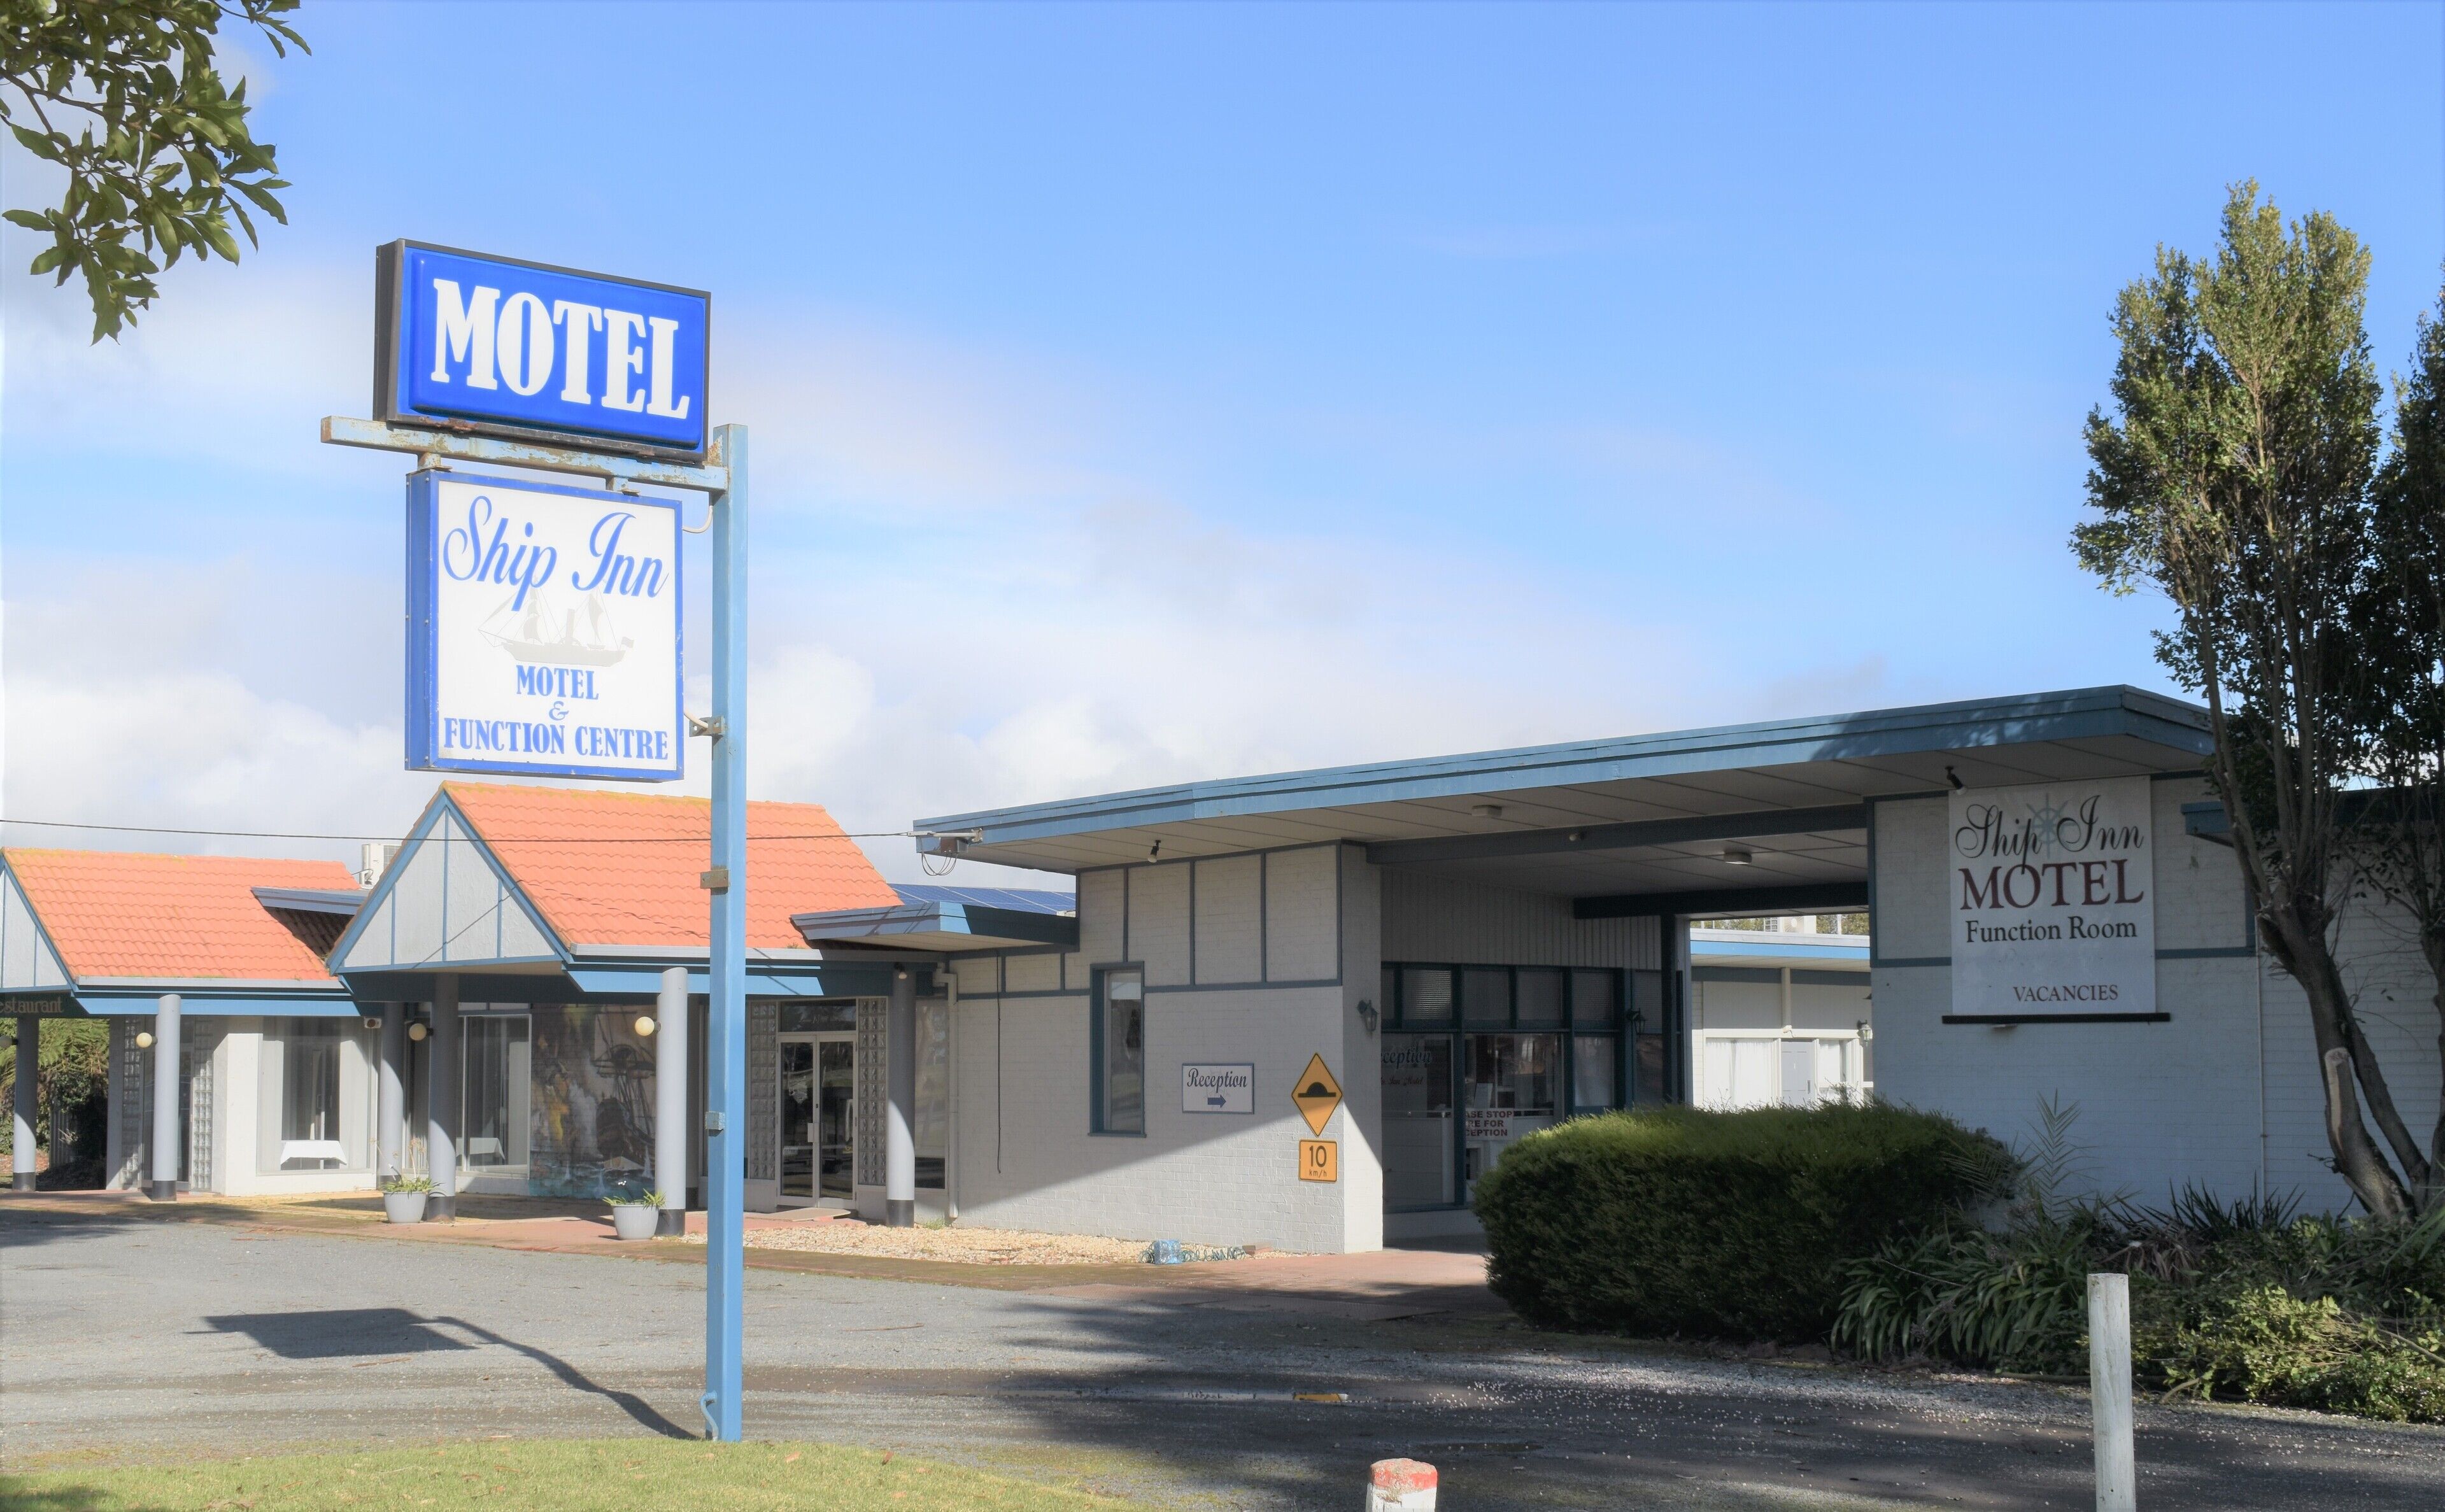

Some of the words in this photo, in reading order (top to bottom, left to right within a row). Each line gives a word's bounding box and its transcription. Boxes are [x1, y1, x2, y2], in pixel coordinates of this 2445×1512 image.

[431, 278, 690, 420] MOTEL
[443, 495, 557, 612] Ship
[571, 512, 670, 598] Inn
[516, 665, 599, 700] MOTEL
[548, 701, 570, 721] &
[444, 717, 565, 755] FUNCTION
[574, 726, 669, 760] CENTRE
[1955, 804, 2043, 875] Ship
[2056, 795, 2144, 852] Inn
[1958, 859, 2144, 910] MOTEL
[1966, 919, 2061, 943] Function
[2068, 915, 2137, 940] Room
[2013, 984, 2119, 1002] VACANCIES
[1187, 1068, 1247, 1093] Reception
[1309, 1145, 1327, 1168] 10
[1309, 1169, 1328, 1178] km/h
